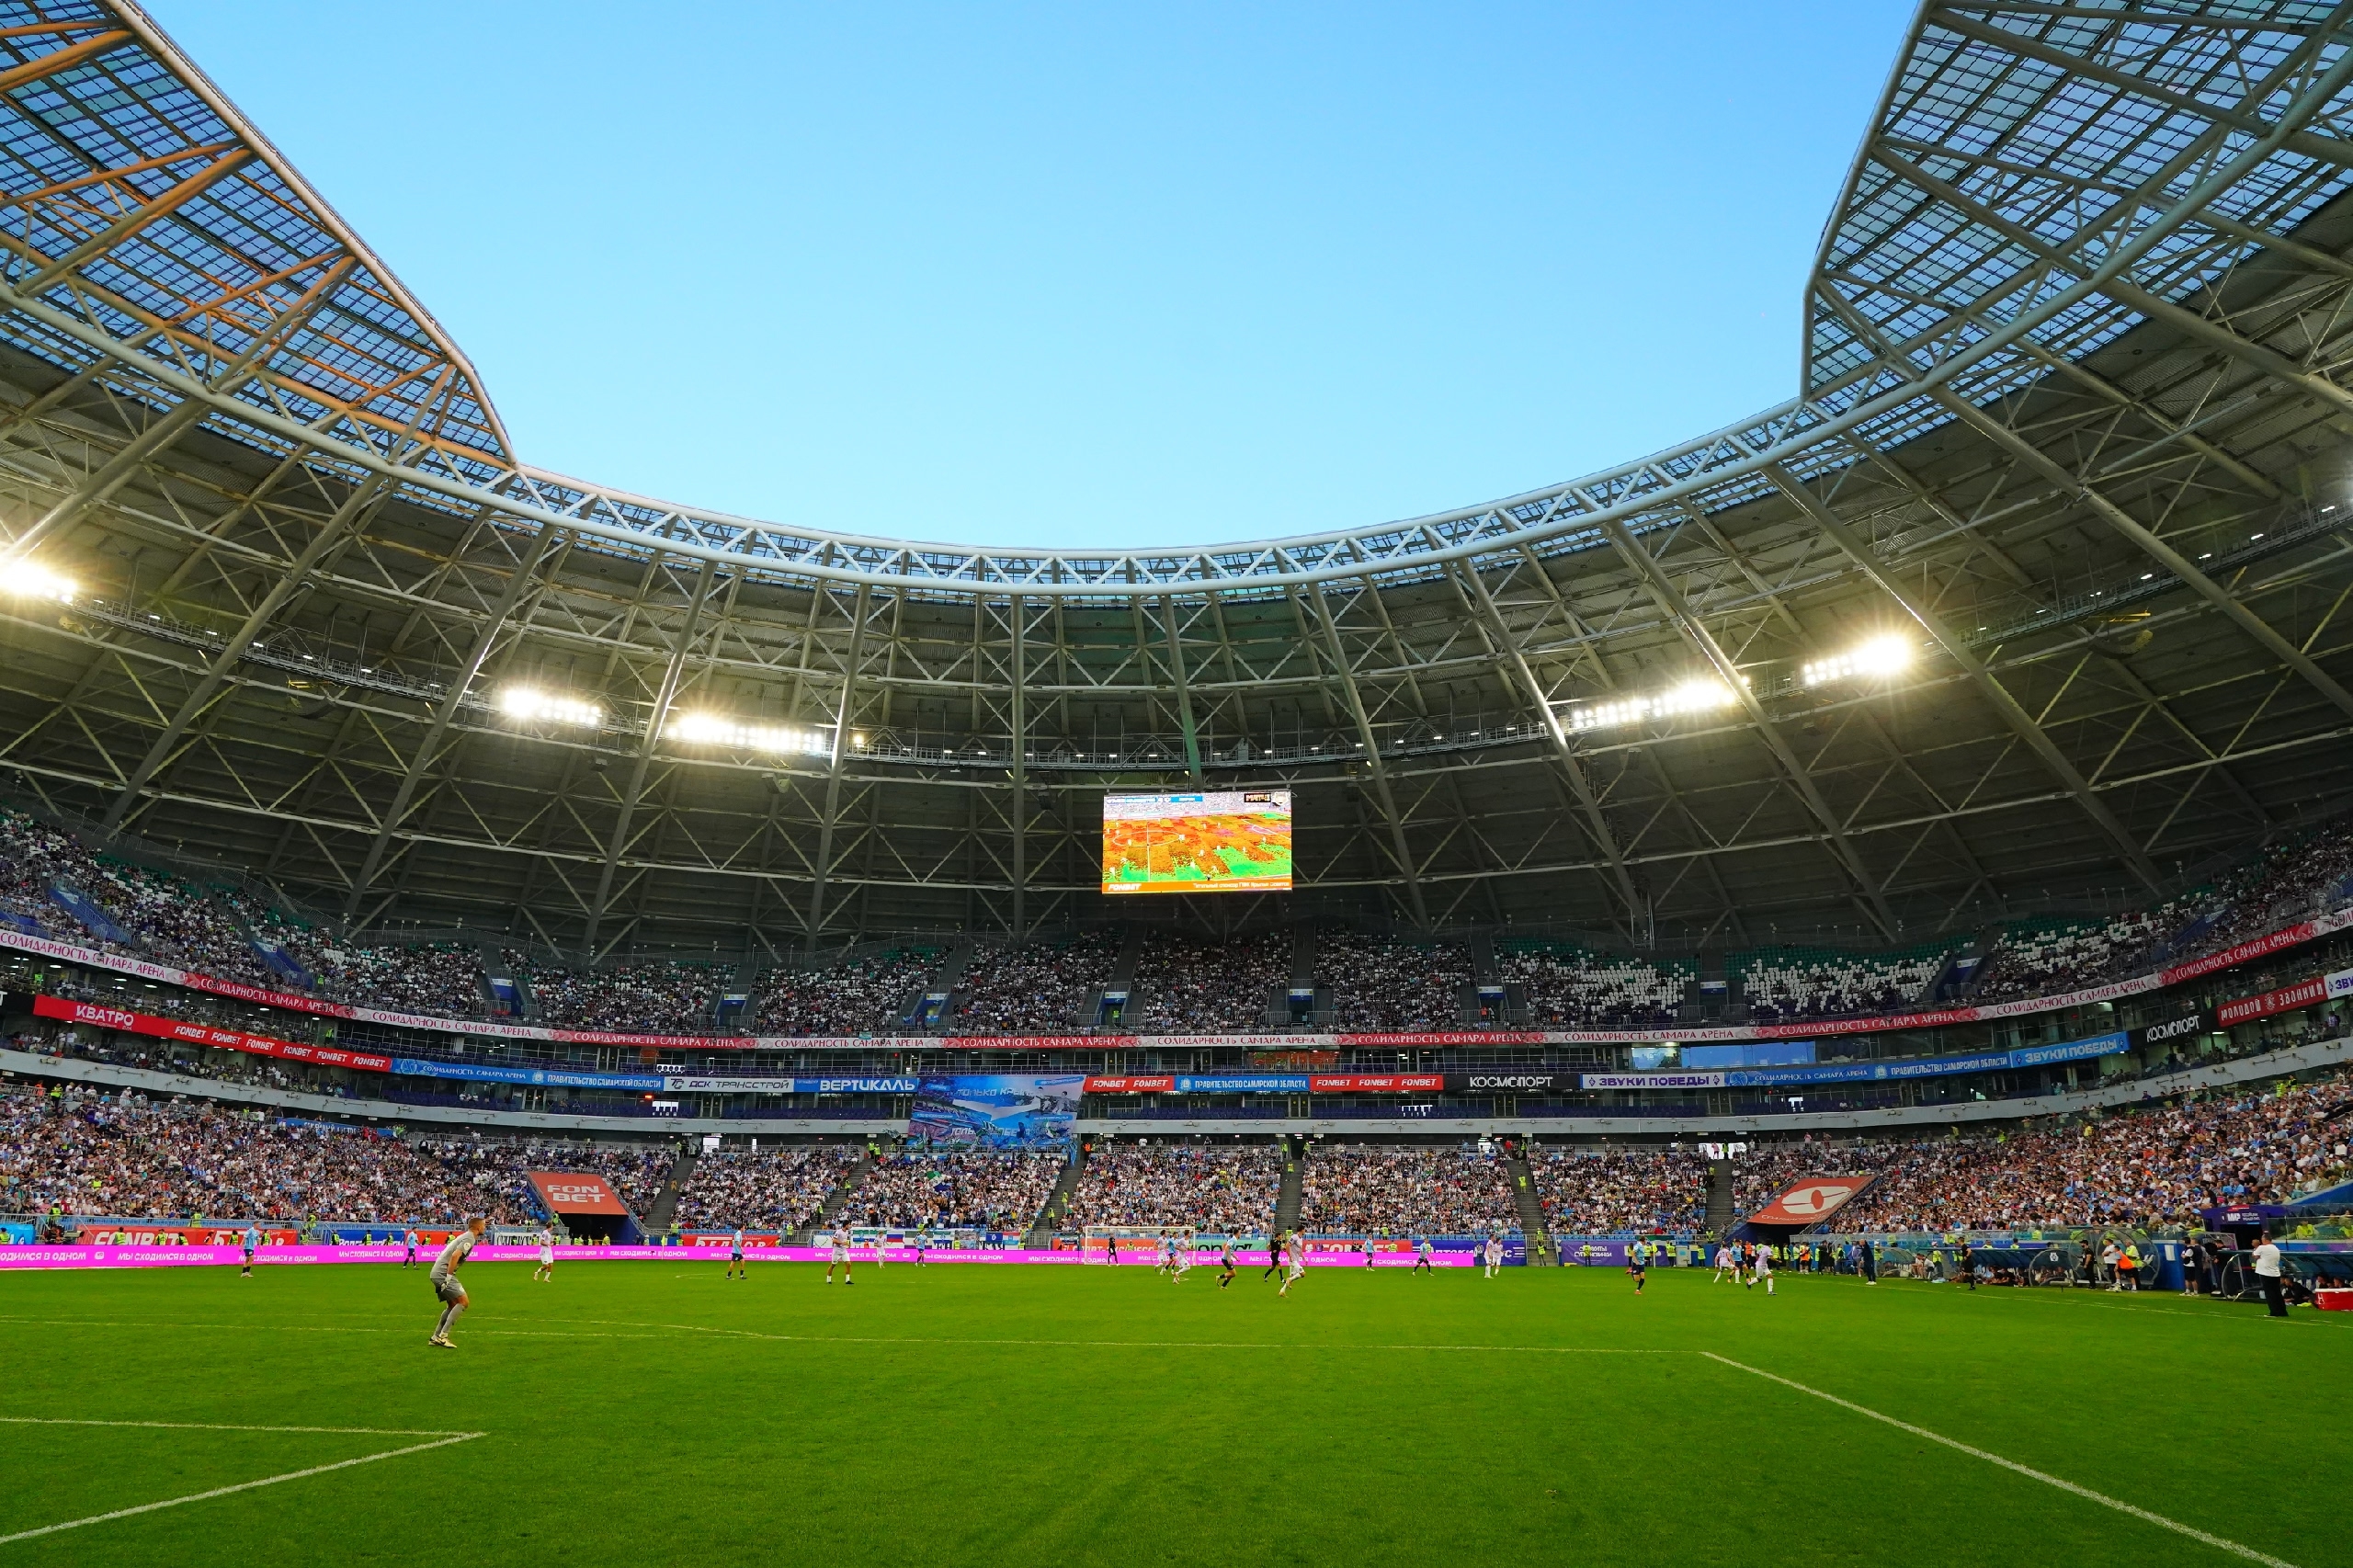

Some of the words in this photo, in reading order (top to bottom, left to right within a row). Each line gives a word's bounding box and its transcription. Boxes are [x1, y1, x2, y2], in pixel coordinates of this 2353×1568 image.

[2234, 941, 2267, 959] САМАРА
[2269, 930, 2295, 948] АРЕНА
[1, 932, 88, 961] СОЛИДАРНОСТЬ
[136, 963, 165, 979] АРЕНА
[2079, 983, 2117, 1000] САМАРА
[2120, 980, 2146, 994] АРЕНА
[269, 994, 304, 1009] САМАРА
[2221, 997, 2261, 1020] МОЛОДОЙ
[2279, 983, 2324, 1006] ЗВОНКИЙ
[75, 1005, 134, 1027] КВАТРО
[1922, 1012, 1954, 1023] АРЕНА
[175, 1025, 206, 1040] FONBET
[455, 1022, 496, 1034] САМАРА
[500, 1025, 531, 1038] АРЕНА
[2146, 1016, 2200, 1041] КОСМОПОРТ
[211, 1031, 241, 1045] FONBET
[1240, 1036, 1282, 1044] САМАРА
[1285, 1036, 1316, 1044] АРЕНА
[1443, 1033, 1485, 1043] САМАРА
[1653, 1030, 1697, 1040] САМАРА
[1700, 1029, 1733, 1039] АРЕНА
[246, 1039, 275, 1051] FONBET
[660, 1035, 701, 1047] САМАРА
[704, 1037, 735, 1048] АРЕНА
[895, 1039, 924, 1047] АРЕНА
[1043, 1037, 1083, 1047] САМАРА
[1086, 1037, 1116, 1046] АРЕНА
[283, 1045, 312, 1057] FONBET
[317, 1051, 347, 1062] FONBET
[2025, 1048, 2068, 1063] ЗВУКИ
[2069, 1039, 2117, 1058] ПОБЕДЫ
[353, 1056, 385, 1067] FONBET
[1891, 1063, 1942, 1075] ПРАВИТЕЛЬСТВО
[1981, 1057, 2007, 1069] ОБЛАСТИ
[1813, 1071, 1844, 1079] САМАРА
[1846, 1069, 1868, 1077] АРЕНА
[716, 1079, 790, 1089] ТРАНССТРОЙ
[820, 1080, 915, 1091] ВЕРТИКАЛЬ
[1092, 1080, 1126, 1088] FONBET
[1195, 1079, 1243, 1089] ПРАВИТЕЛЬСТВО
[1279, 1078, 1306, 1088] ОБЛАСТИ
[1402, 1078, 1437, 1086] FONBET
[1470, 1076, 1553, 1087] КОСМОПОРТ
[1599, 1077, 1646, 1086] ЗВУКИ
[1649, 1076, 1710, 1086] ПОБЕДЫ
[547, 1185, 599, 1193] FON
[553, 1193, 605, 1203] BET
[44, 1252, 50, 1261] В
[52, 1252, 86, 1261] ОДНОМ
[136, 1253, 179, 1261] СХОДИМСЯ
[187, 1253, 213, 1261] ОДНОМ
